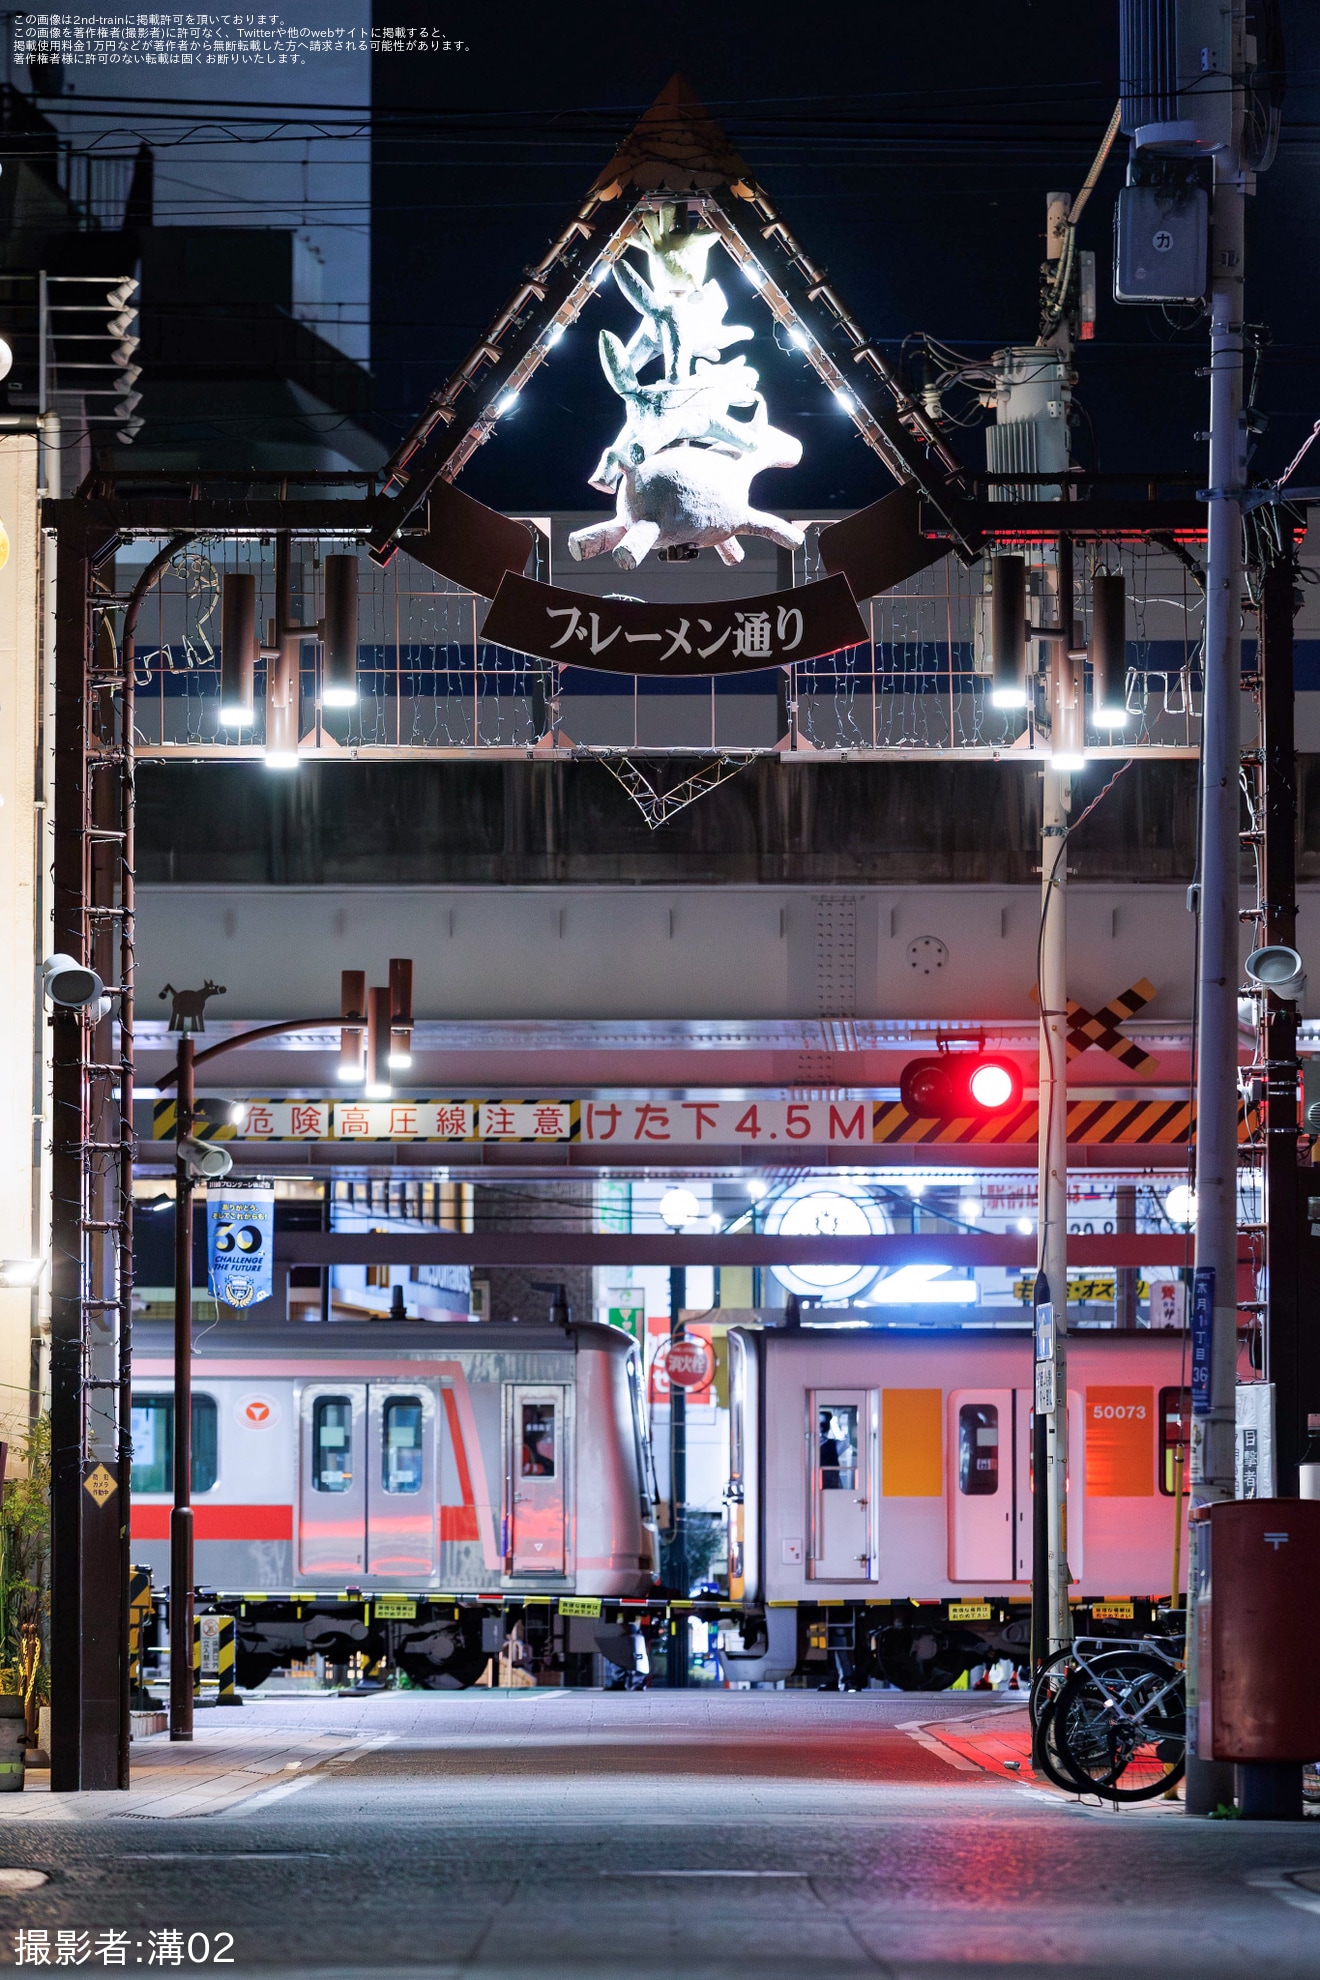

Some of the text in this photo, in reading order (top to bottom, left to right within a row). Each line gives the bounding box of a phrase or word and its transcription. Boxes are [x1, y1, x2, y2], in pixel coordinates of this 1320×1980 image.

[546, 605, 804, 661] ブレーメン通り
[244, 1106, 563, 1135] 危険 高圧線 注意
[587, 1103, 865, 1140] けた下4.5M
[215, 1256, 263, 1265] CHALLENGE
[231, 1264, 262, 1272] FUTURE
[668, 1354, 705, 1374] 消火栓
[1193, 1366, 1209, 1383] 36
[1093, 1405, 1147, 1419] 50073
